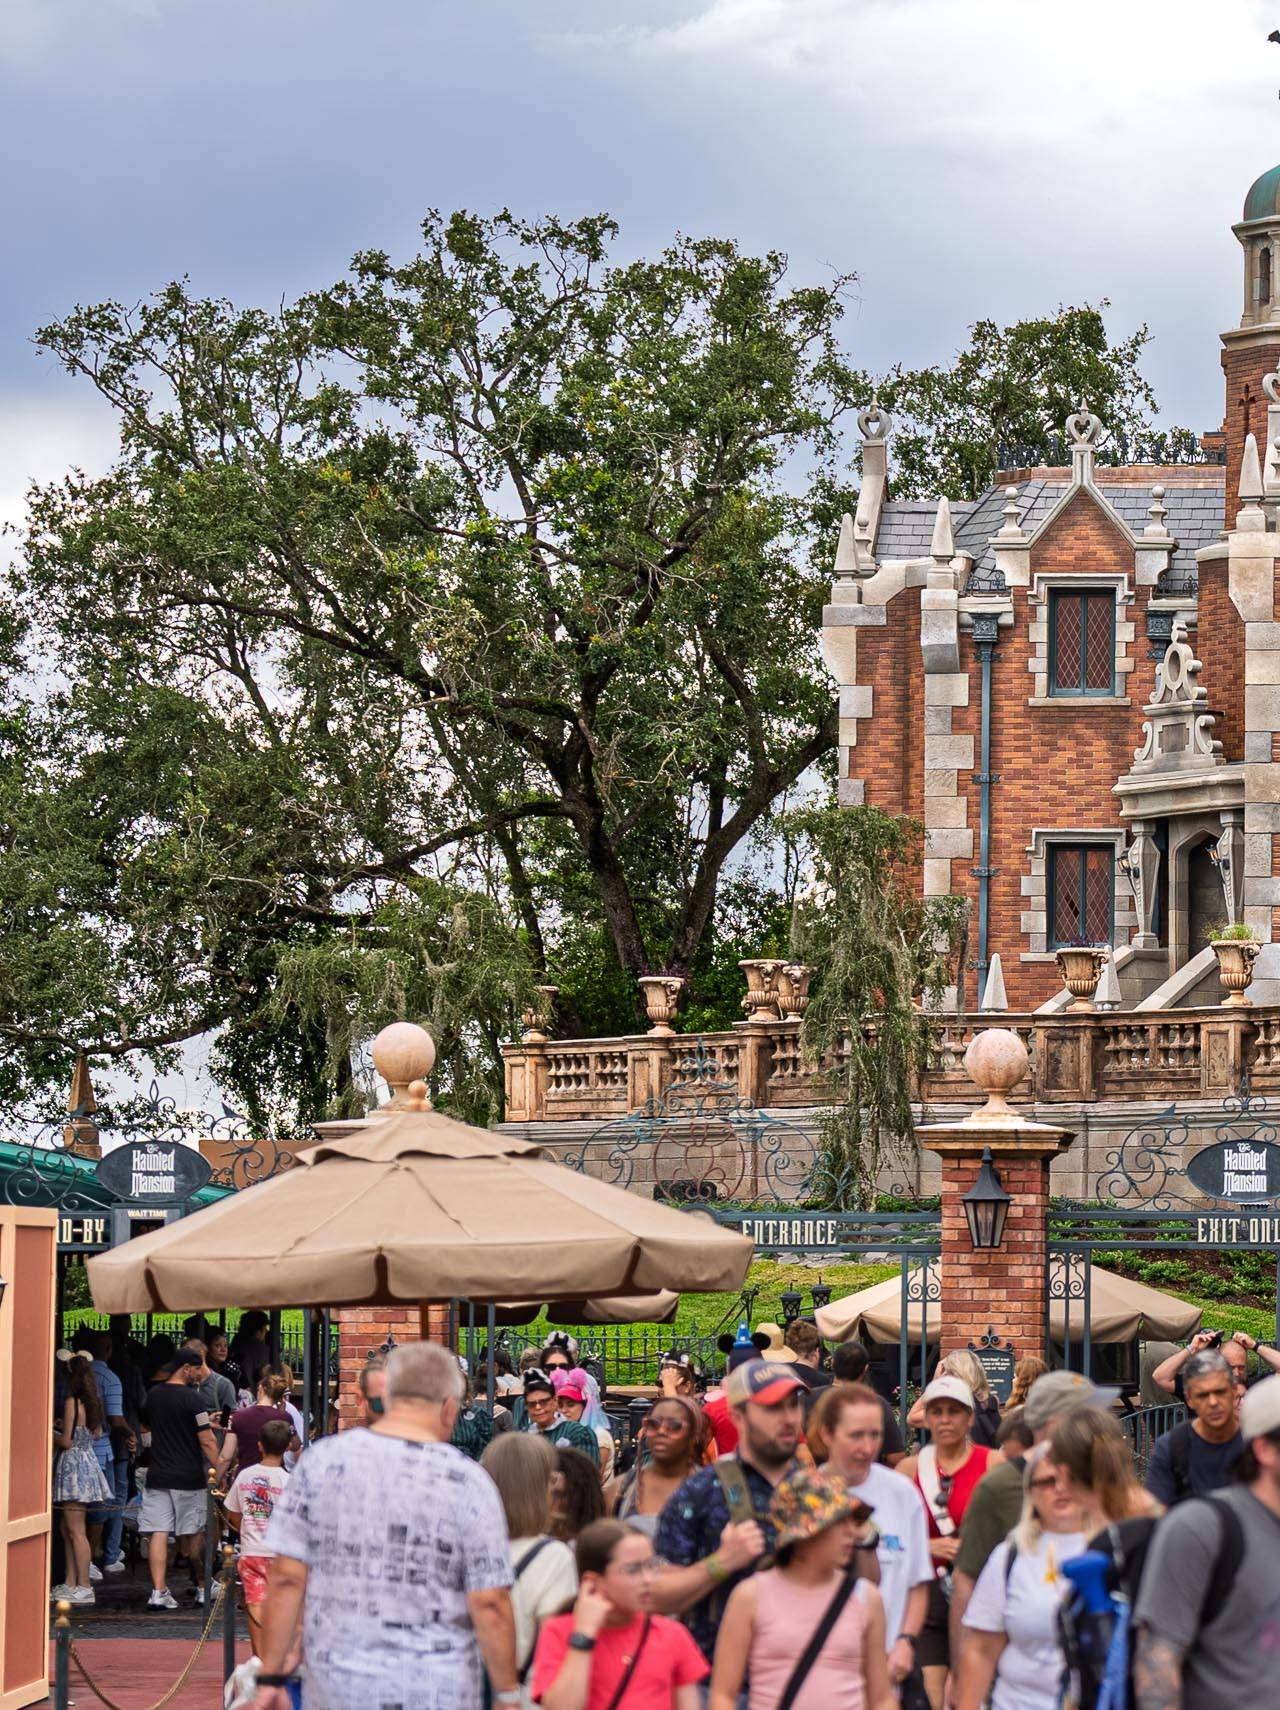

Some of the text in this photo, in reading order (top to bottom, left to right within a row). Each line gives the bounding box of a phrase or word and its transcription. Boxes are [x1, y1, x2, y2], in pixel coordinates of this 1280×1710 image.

[132, 1149, 175, 1171] Haunted
[1223, 1148, 1267, 1170] Haunted
[130, 1172, 175, 1197] Mansion
[1221, 1171, 1268, 1196] Mansion
[127, 1209, 168, 1218] WAIT TIME
[742, 1220, 837, 1245] ENTRANCE
[1197, 1218, 1240, 1243] EXIT
